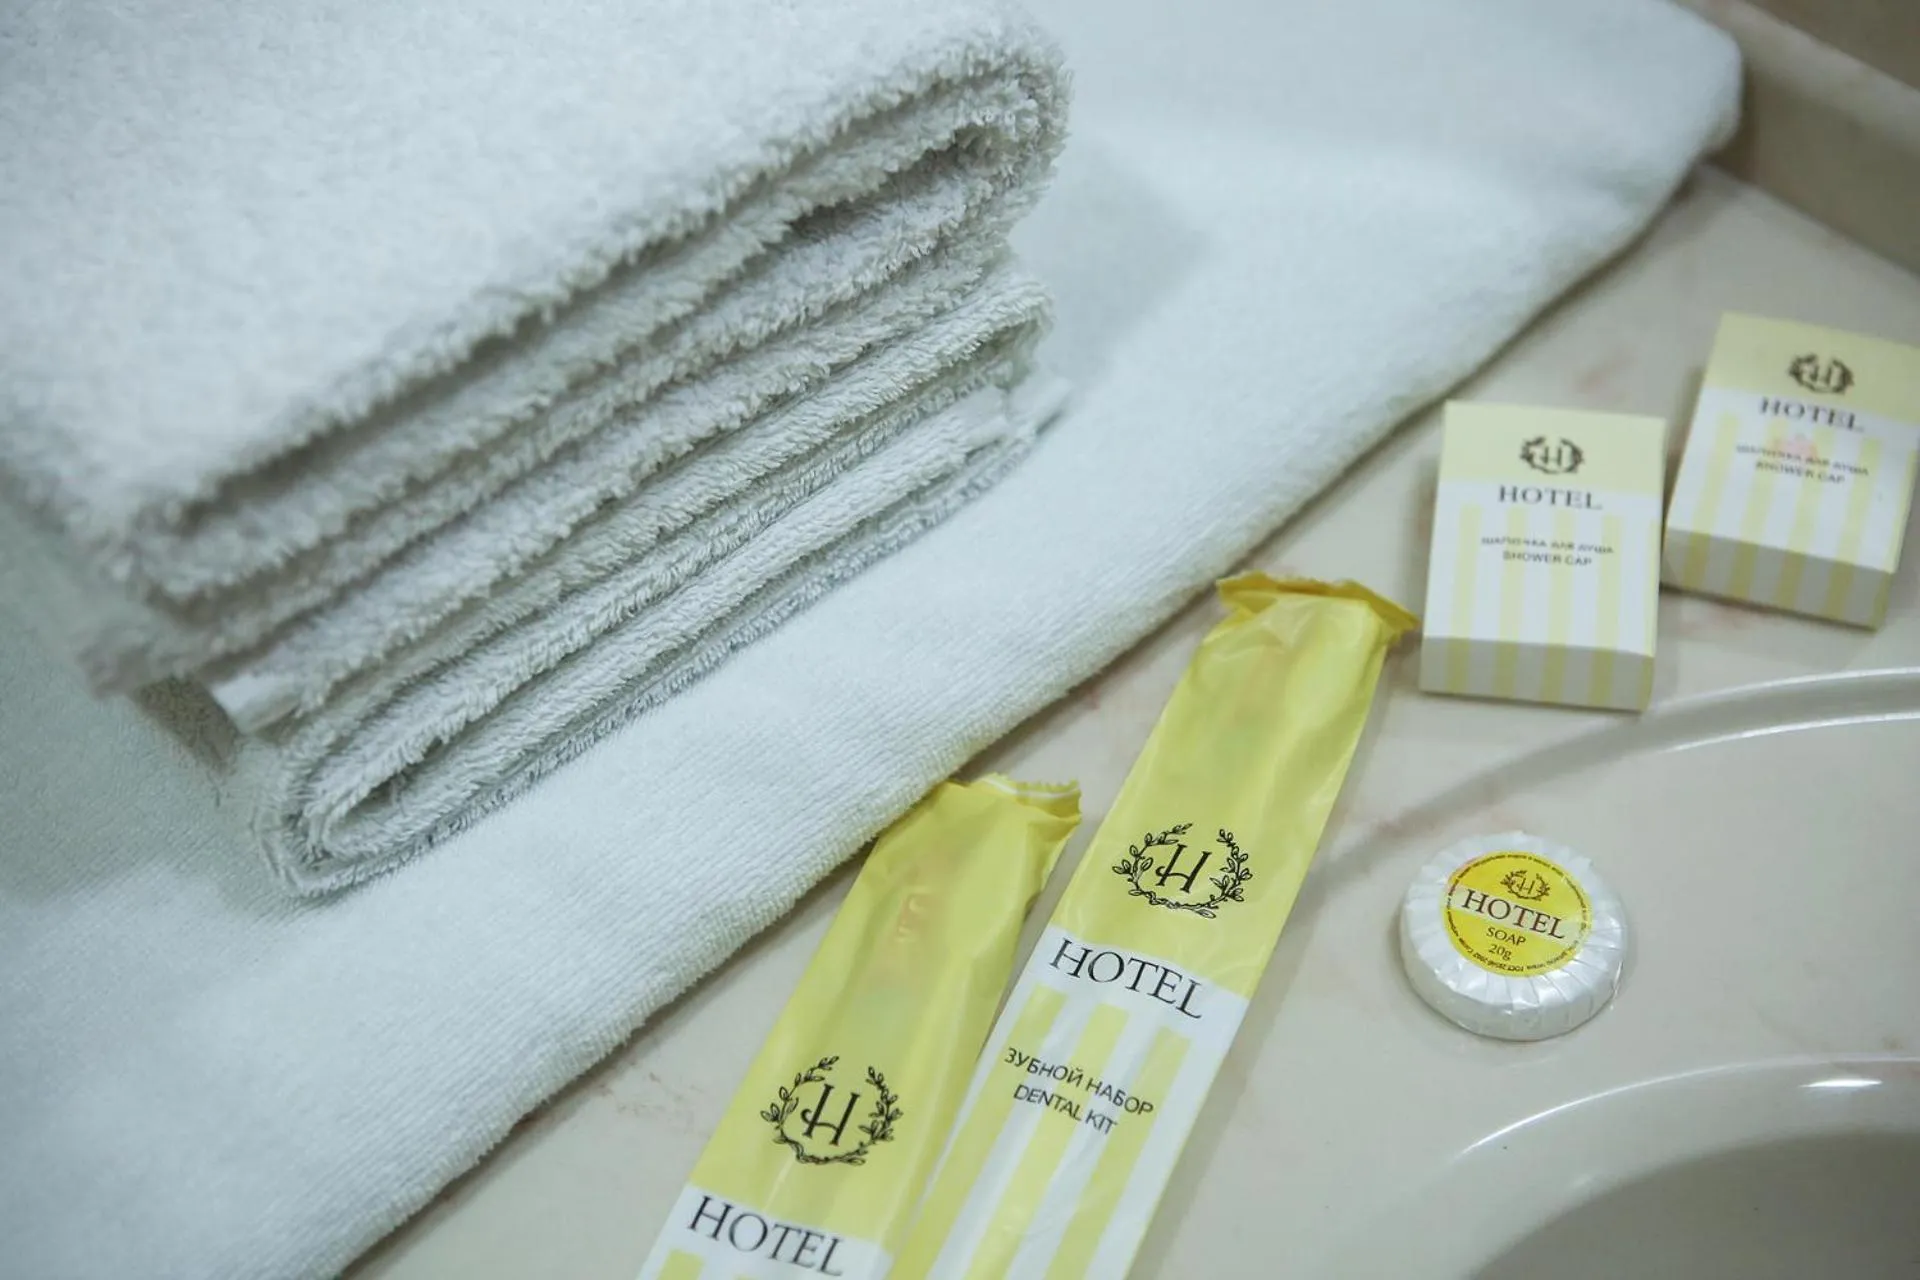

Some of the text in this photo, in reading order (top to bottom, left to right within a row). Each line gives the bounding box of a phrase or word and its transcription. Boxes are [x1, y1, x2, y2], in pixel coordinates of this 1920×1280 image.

[1759, 396, 1865, 433] HOTEL
[1498, 484, 1604, 511] HOTEL
[1755, 460, 1846, 484] SHOWER CAP
[1502, 549, 1593, 567] SHOWER CAP
[1155, 842, 1212, 894] H
[1462, 888, 1566, 940] HOTEL
[1486, 926, 1527, 946] SOAP
[1049, 936, 1203, 1019] HOTEL
[1488, 943, 1513, 961] 20g
[1004, 1047, 1154, 1116] ЗУБНОЙ НАБОР
[800, 1083, 861, 1147] H
[1013, 1083, 1119, 1136] DENTAL KIT
[686, 1194, 845, 1278] HOTEL
